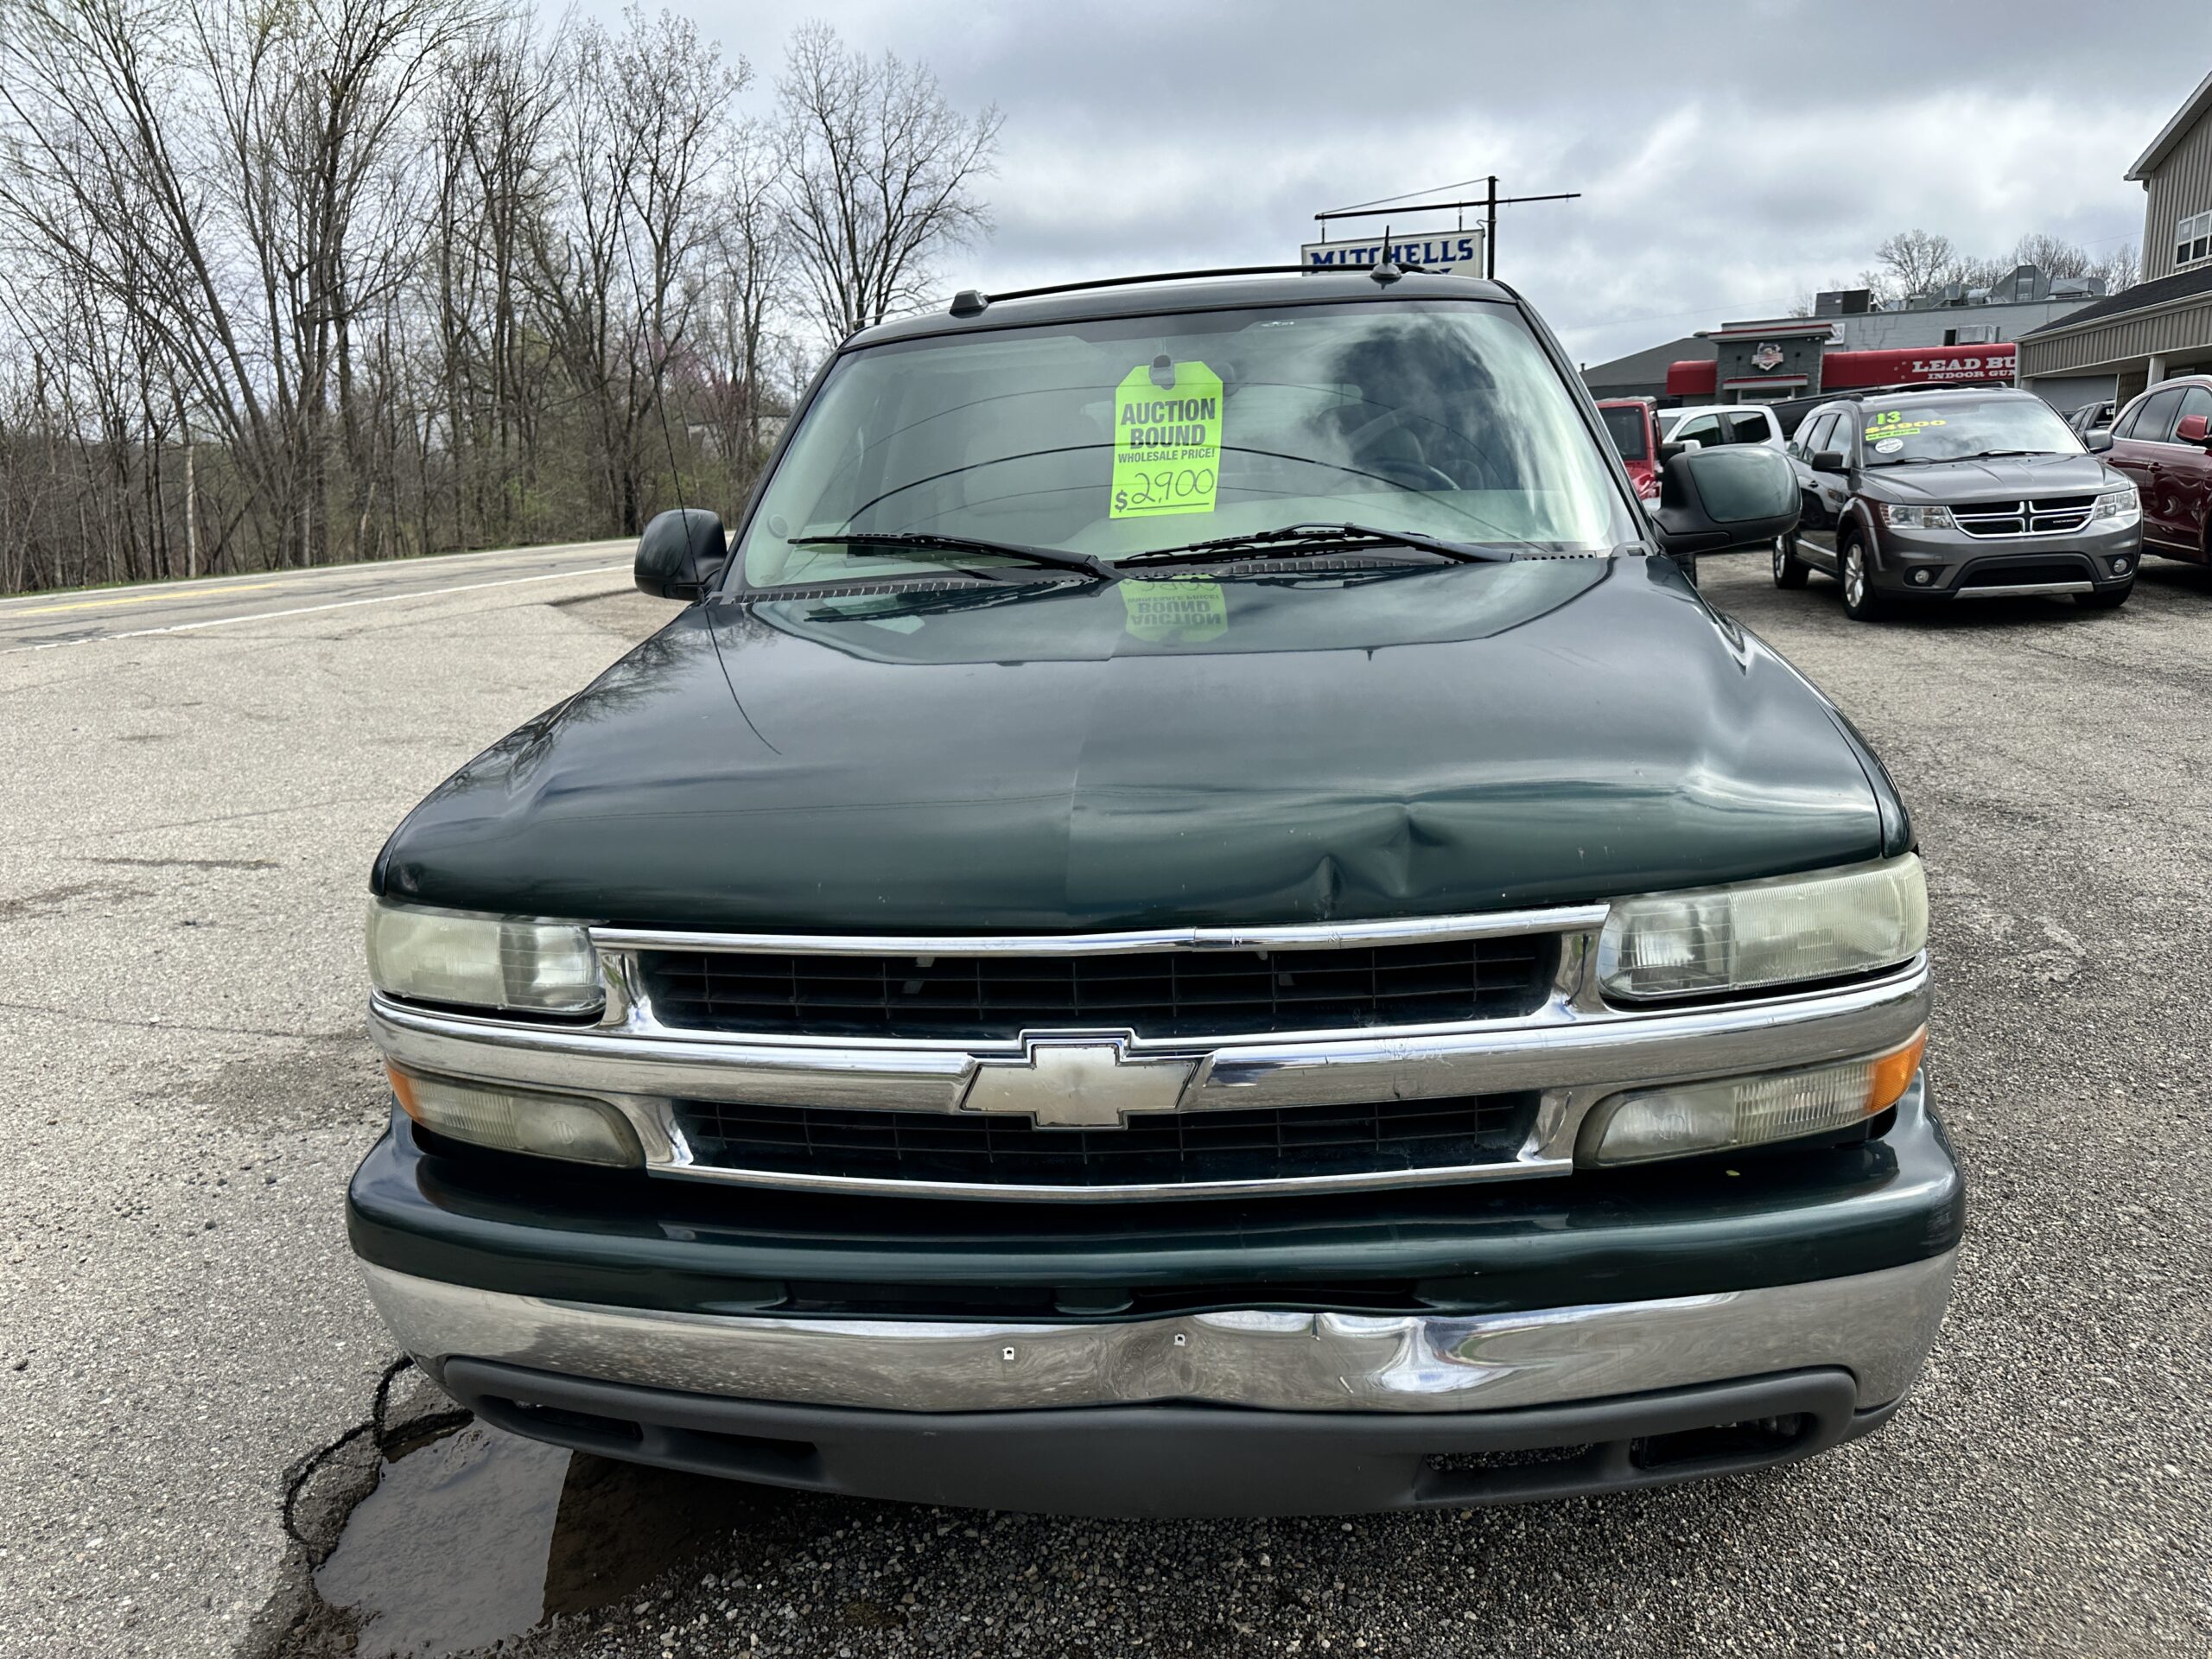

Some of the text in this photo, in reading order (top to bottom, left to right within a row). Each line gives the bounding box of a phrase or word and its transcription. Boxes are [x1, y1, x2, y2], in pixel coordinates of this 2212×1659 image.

[1911, 358, 1981, 372] LEAD
[1928, 371, 1985, 380] INDOOR
[1121, 397, 1216, 425] AUCTION
[1877, 410, 1901, 425] 13
[1130, 424, 1205, 449] BOUND
[1118, 448, 1215, 463] WHOLESALE PRICE!
